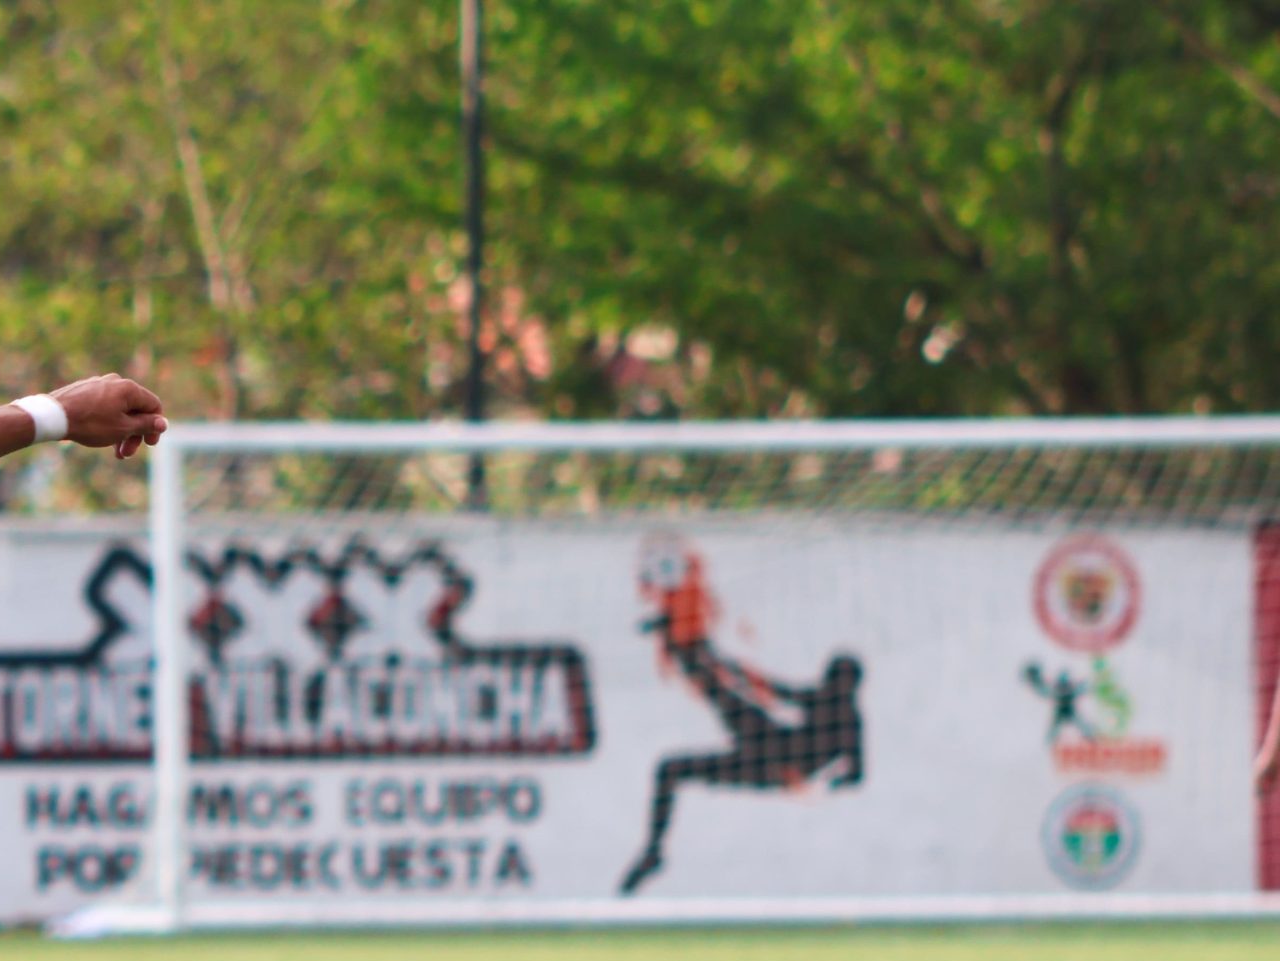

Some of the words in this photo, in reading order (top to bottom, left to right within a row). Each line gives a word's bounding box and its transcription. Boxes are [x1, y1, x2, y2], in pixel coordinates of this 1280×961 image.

[204, 660, 574, 748] VILLACONCHA
[23, 783, 314, 828] HAGMOS
[347, 778, 542, 827] EQUIPO
